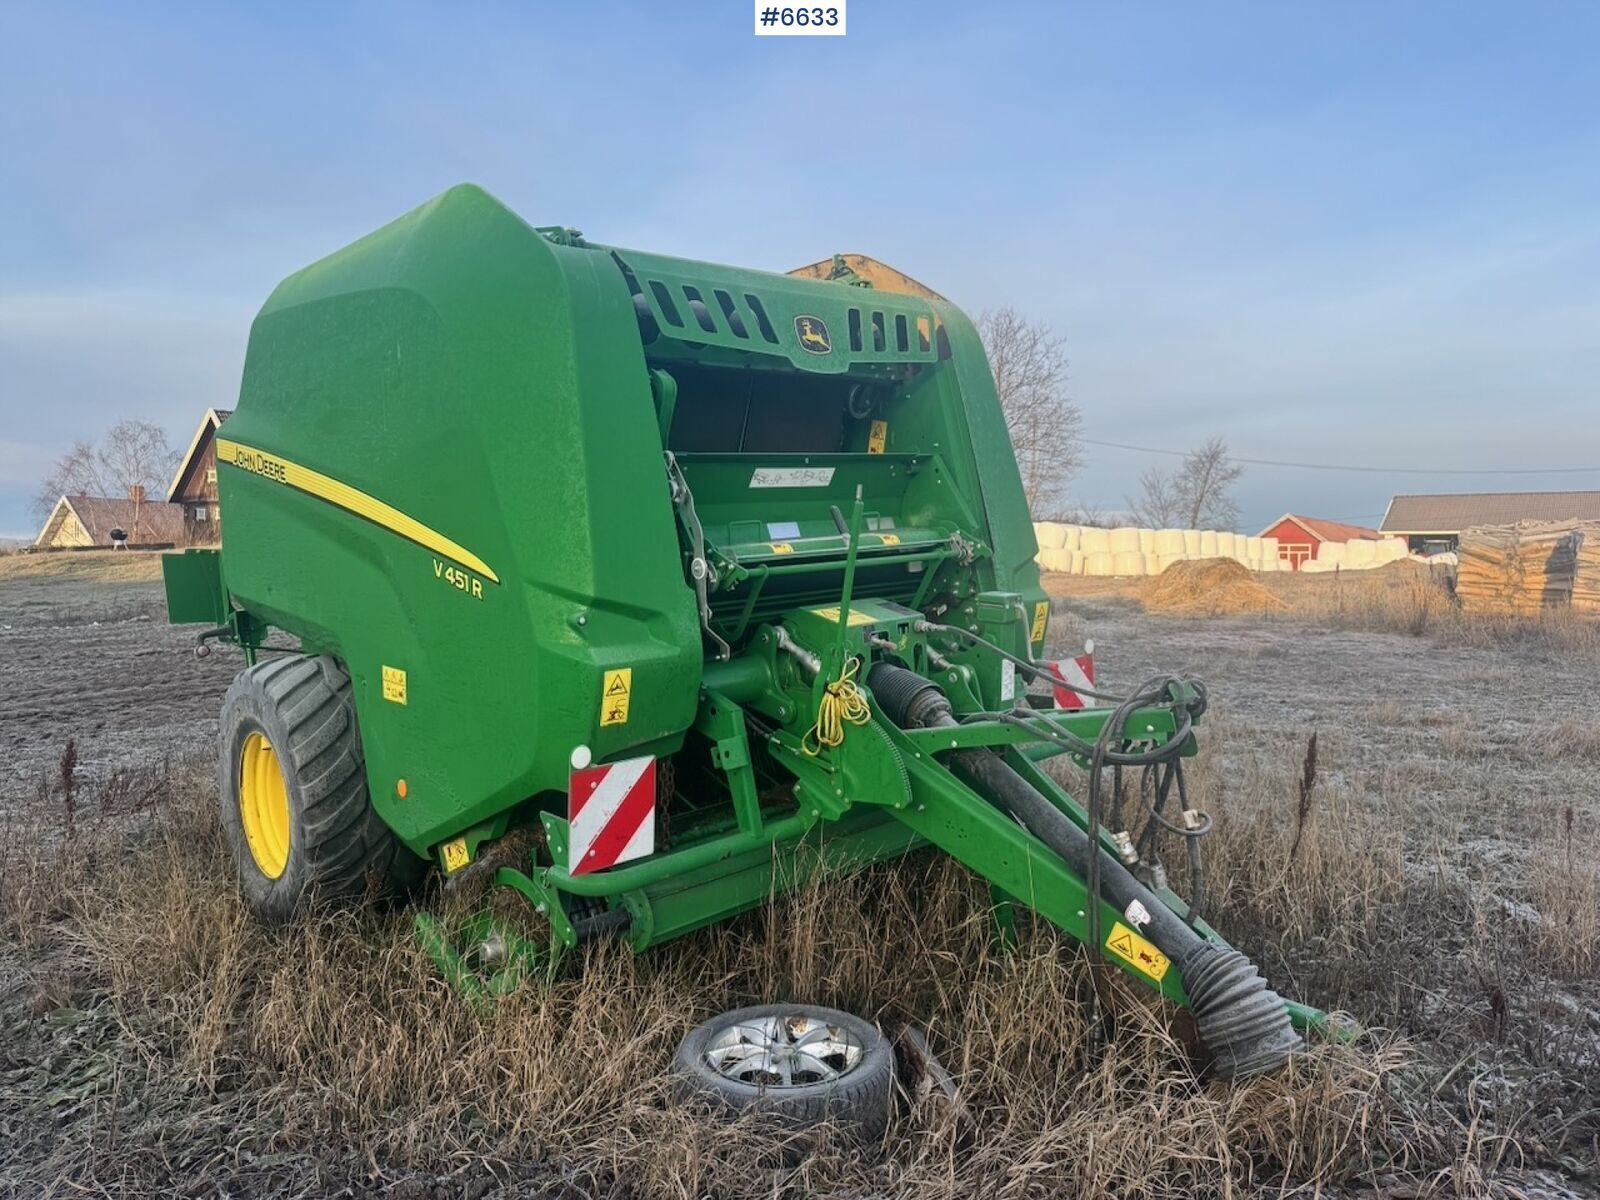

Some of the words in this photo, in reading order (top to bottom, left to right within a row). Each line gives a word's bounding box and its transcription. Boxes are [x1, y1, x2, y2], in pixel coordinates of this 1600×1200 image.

[233, 446, 257, 471] JOHN
[257, 454, 287, 482] DEERE
[433, 558, 443, 578] V
[445, 566, 469, 592] 451
[472, 578, 483, 600] R
